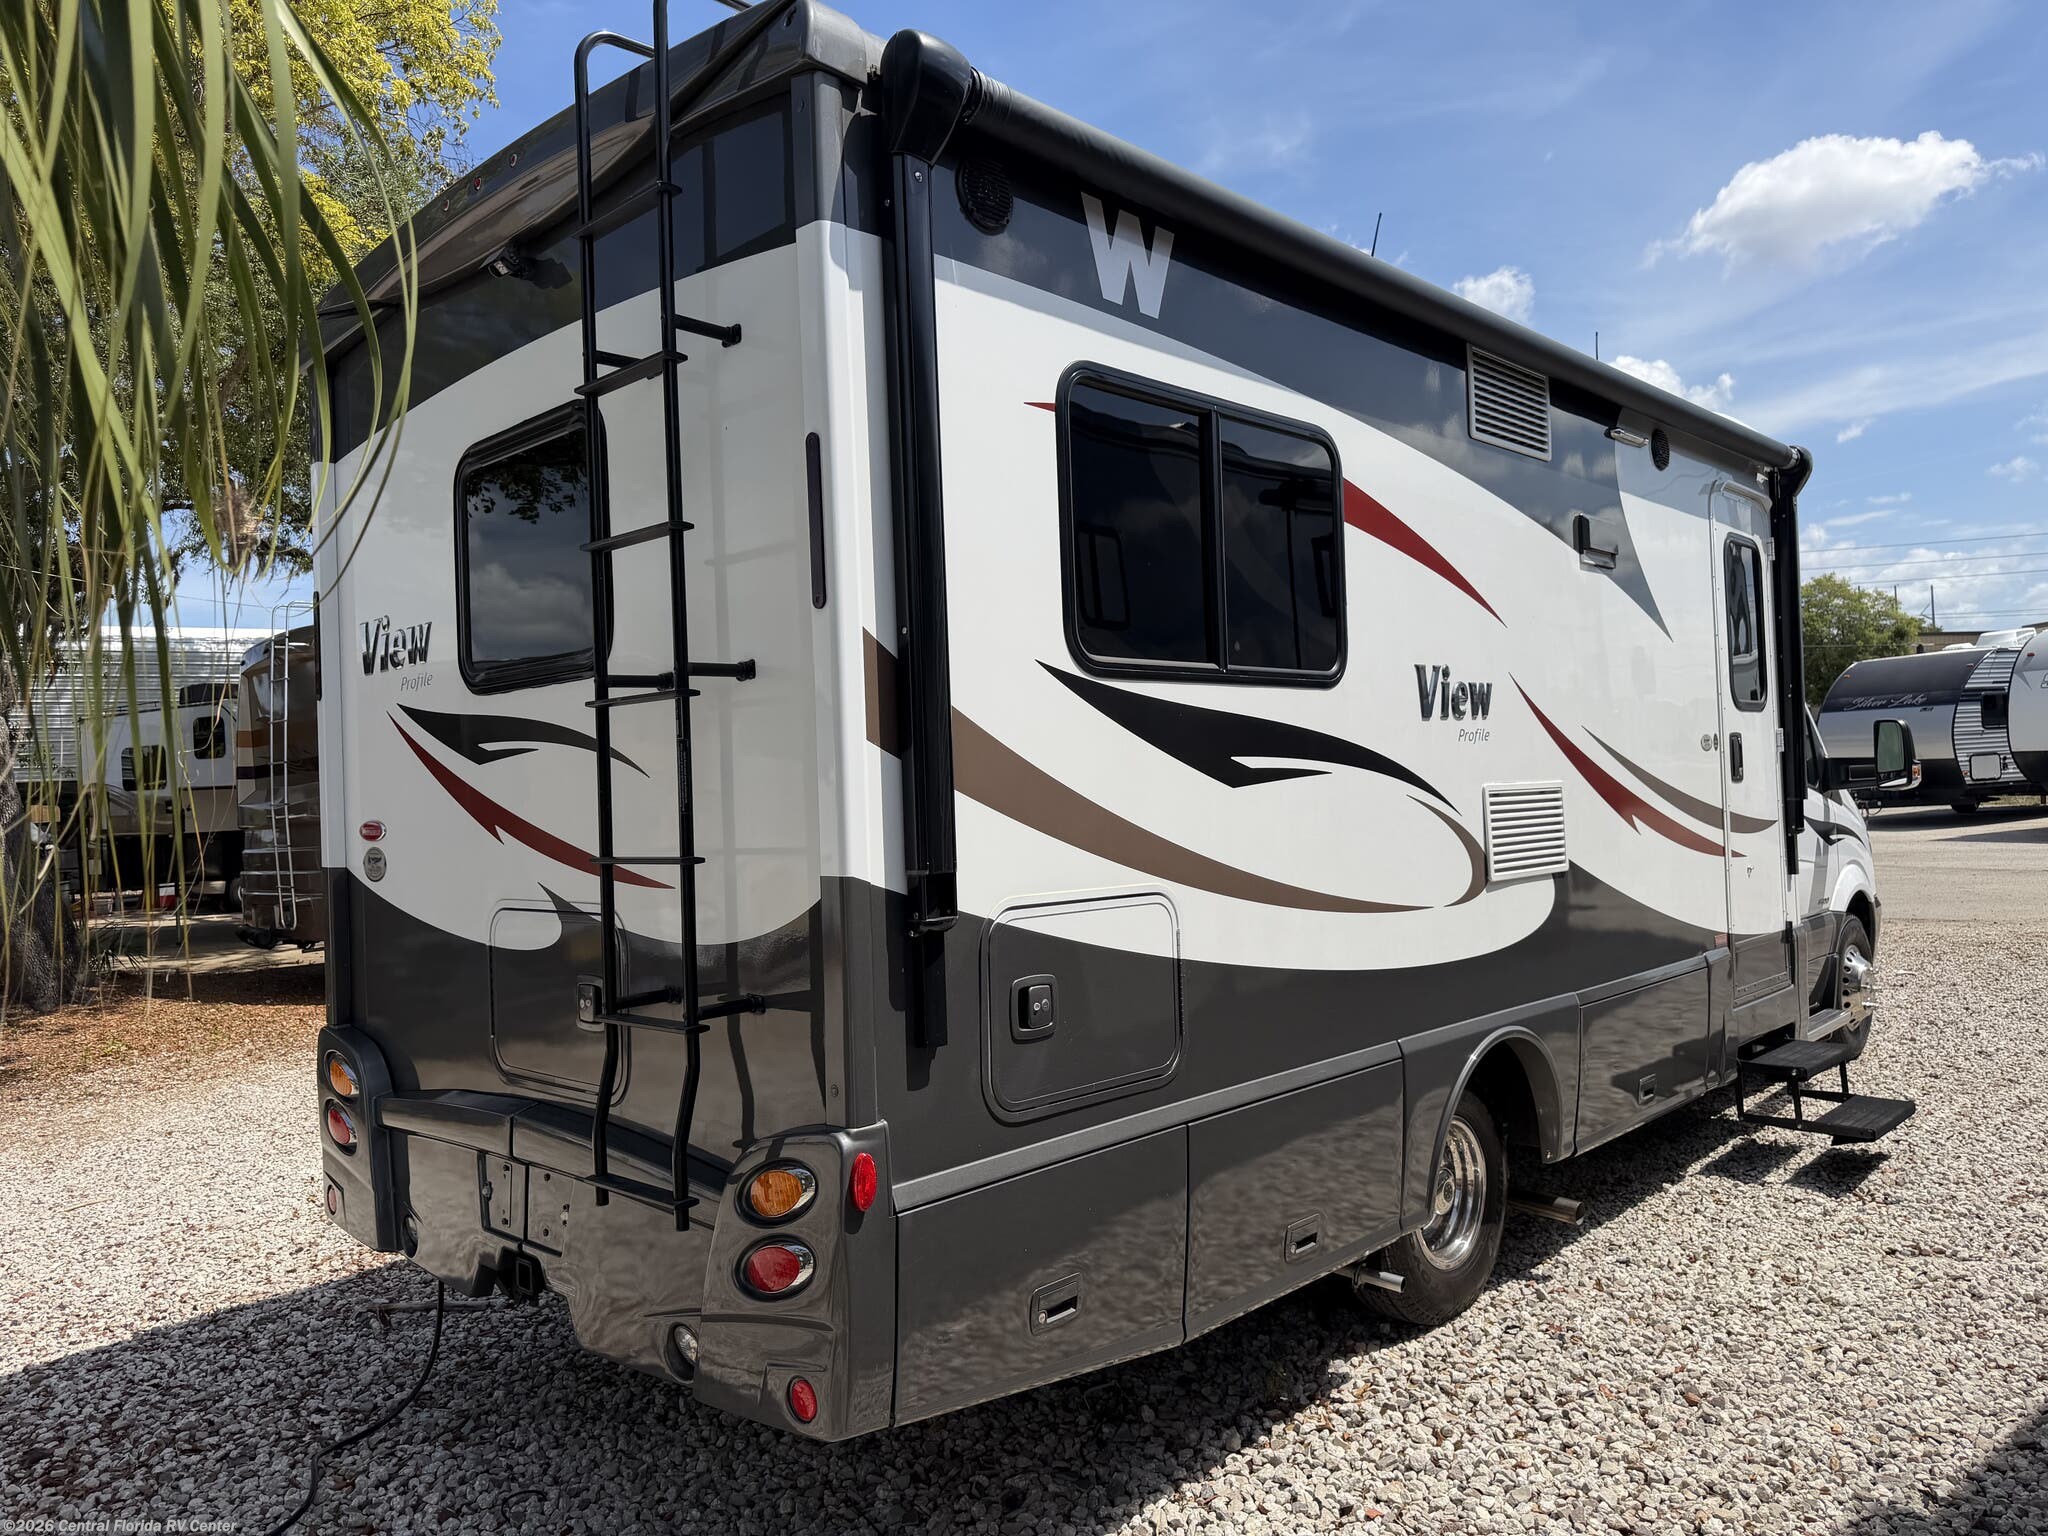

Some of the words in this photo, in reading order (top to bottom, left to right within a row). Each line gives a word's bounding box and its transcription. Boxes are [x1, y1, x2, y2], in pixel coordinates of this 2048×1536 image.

[1081, 191, 1175, 320] W
[360, 615, 433, 676] View
[400, 672, 433, 692] Profile
[1413, 663, 1493, 722] View
[1458, 728, 1490, 744] Profile
